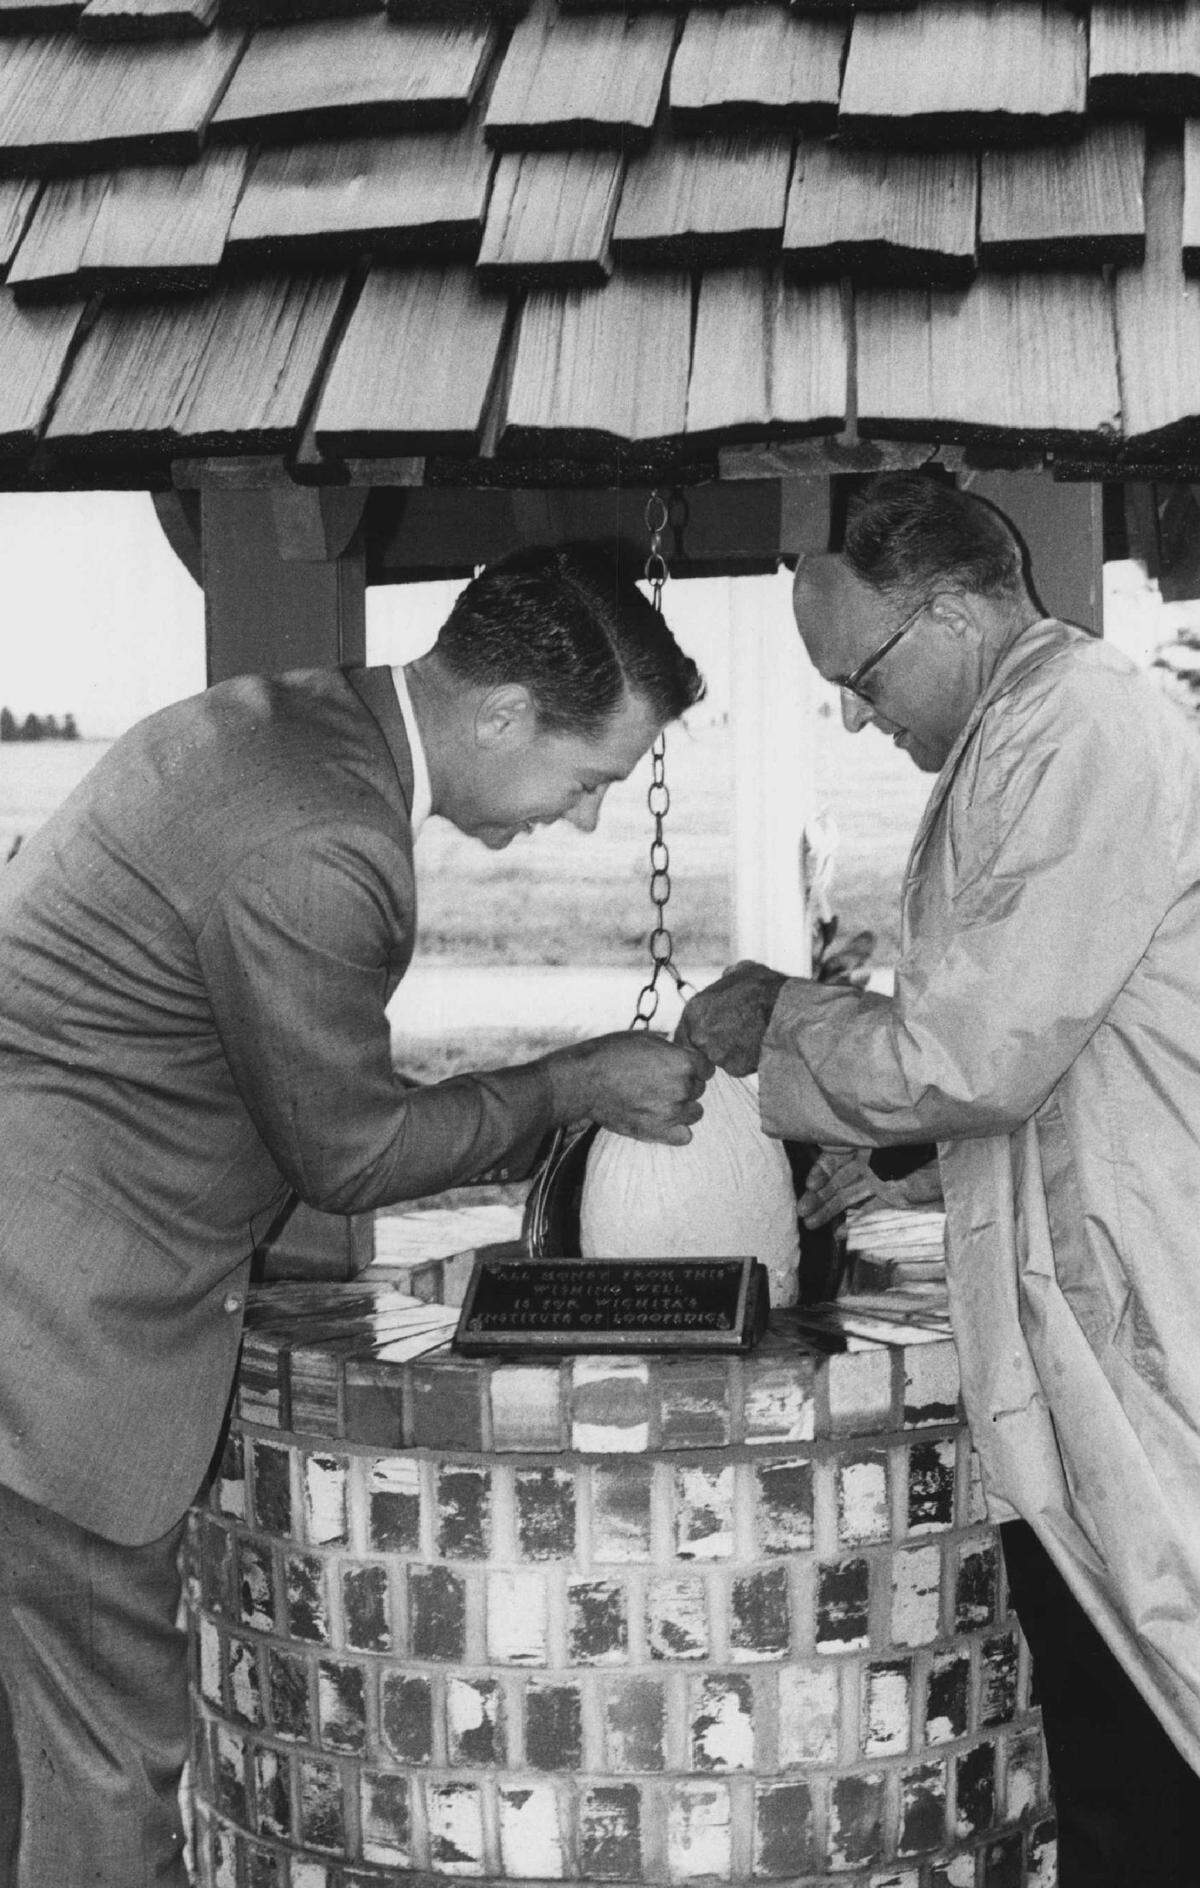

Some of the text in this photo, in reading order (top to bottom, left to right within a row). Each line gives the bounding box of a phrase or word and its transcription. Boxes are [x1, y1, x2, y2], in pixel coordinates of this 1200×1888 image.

[496, 1268, 726, 1282] ALL MONEY FROM THIS
[532, 1283, 684, 1296] WISHING WELL
[513, 1298, 531, 1310] IS
[541, 1298, 580, 1310] FOR
[578, 1312, 604, 1325] OF
